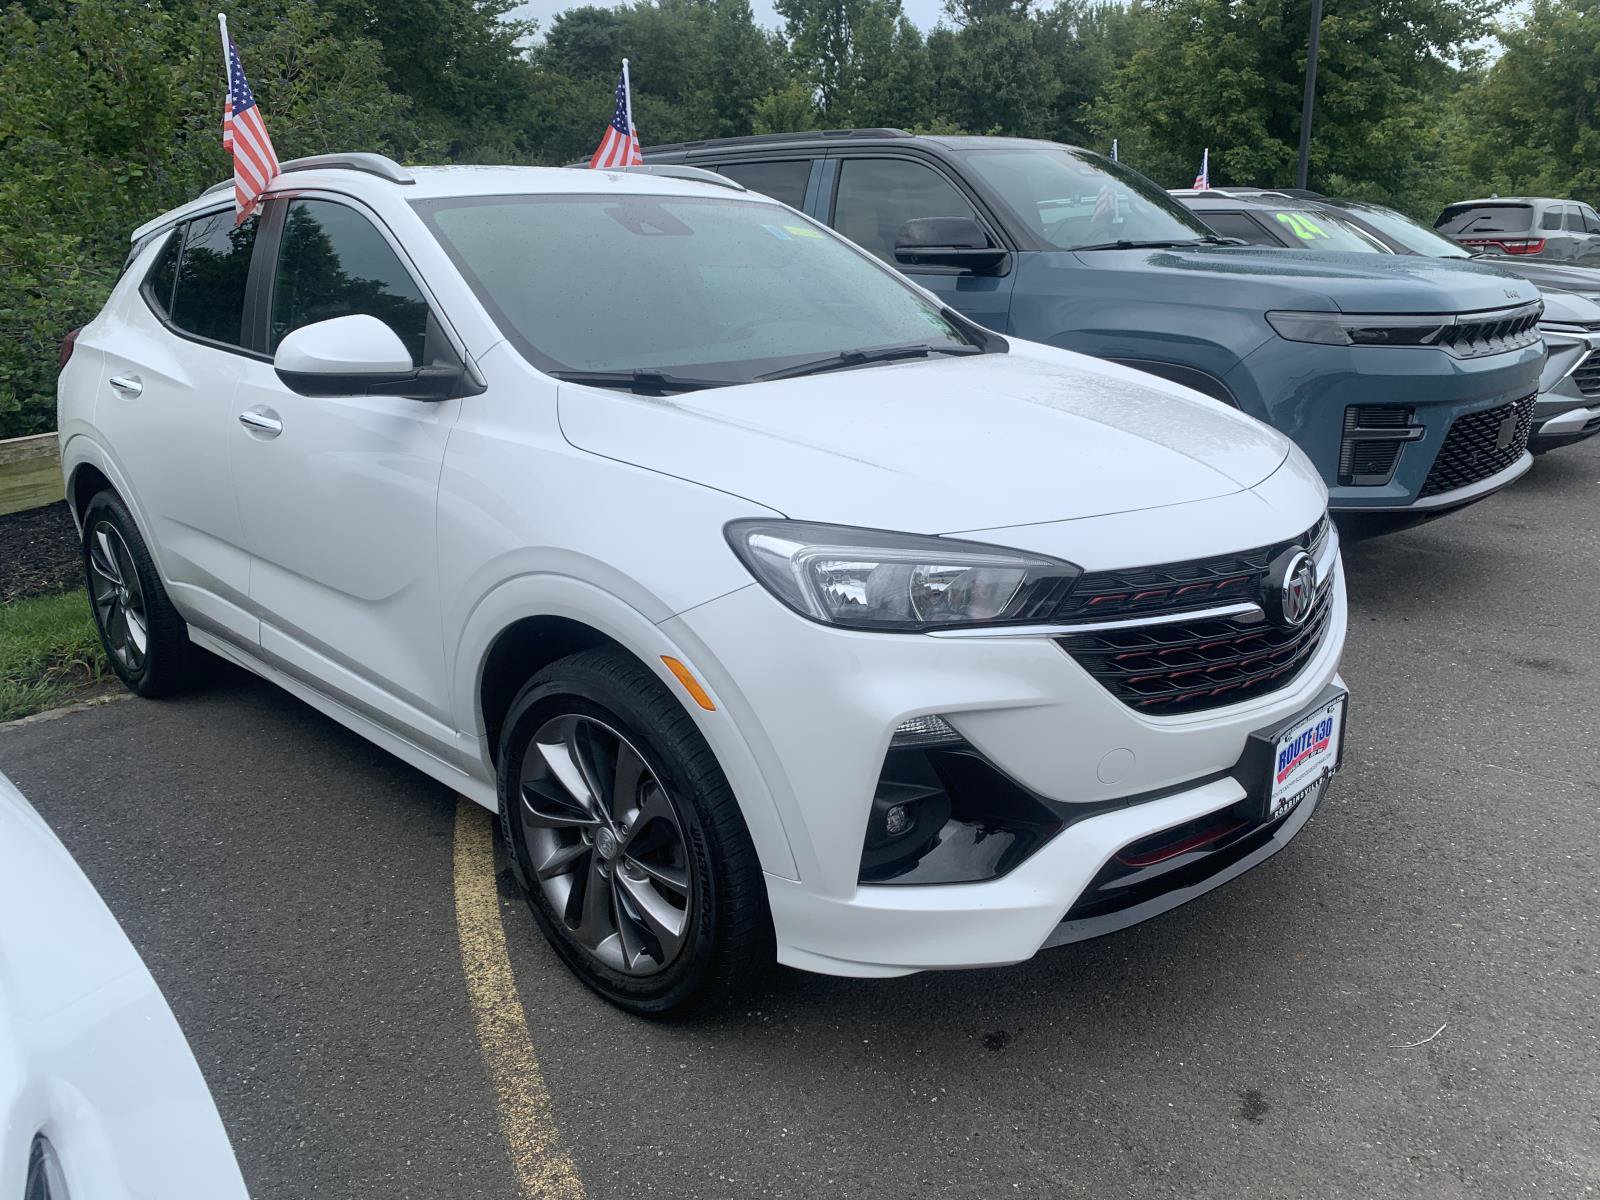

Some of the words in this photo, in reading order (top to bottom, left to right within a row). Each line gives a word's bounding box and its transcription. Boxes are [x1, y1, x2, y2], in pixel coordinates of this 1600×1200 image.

[1276, 213, 1331, 240] 24
[1278, 727, 1314, 773] ROUTE
[1315, 717, 1333, 743] 130
